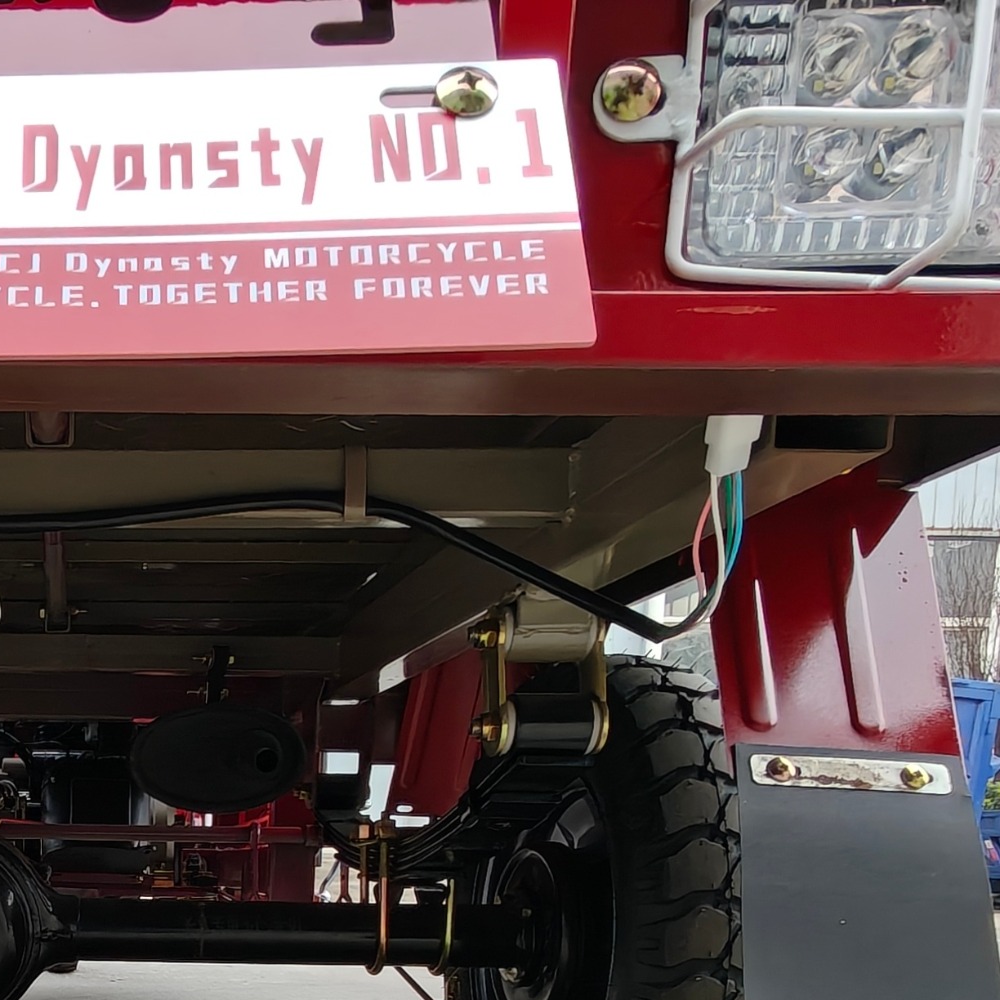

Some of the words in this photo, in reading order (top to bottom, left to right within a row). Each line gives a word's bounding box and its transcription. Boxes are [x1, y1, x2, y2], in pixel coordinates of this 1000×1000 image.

[22, 124, 324, 211] Dyansty
[66, 252, 238, 278] Dynasty
[264, 239, 546, 268] MOTORCYCLE
[354, 273, 549, 300] FOREVER
